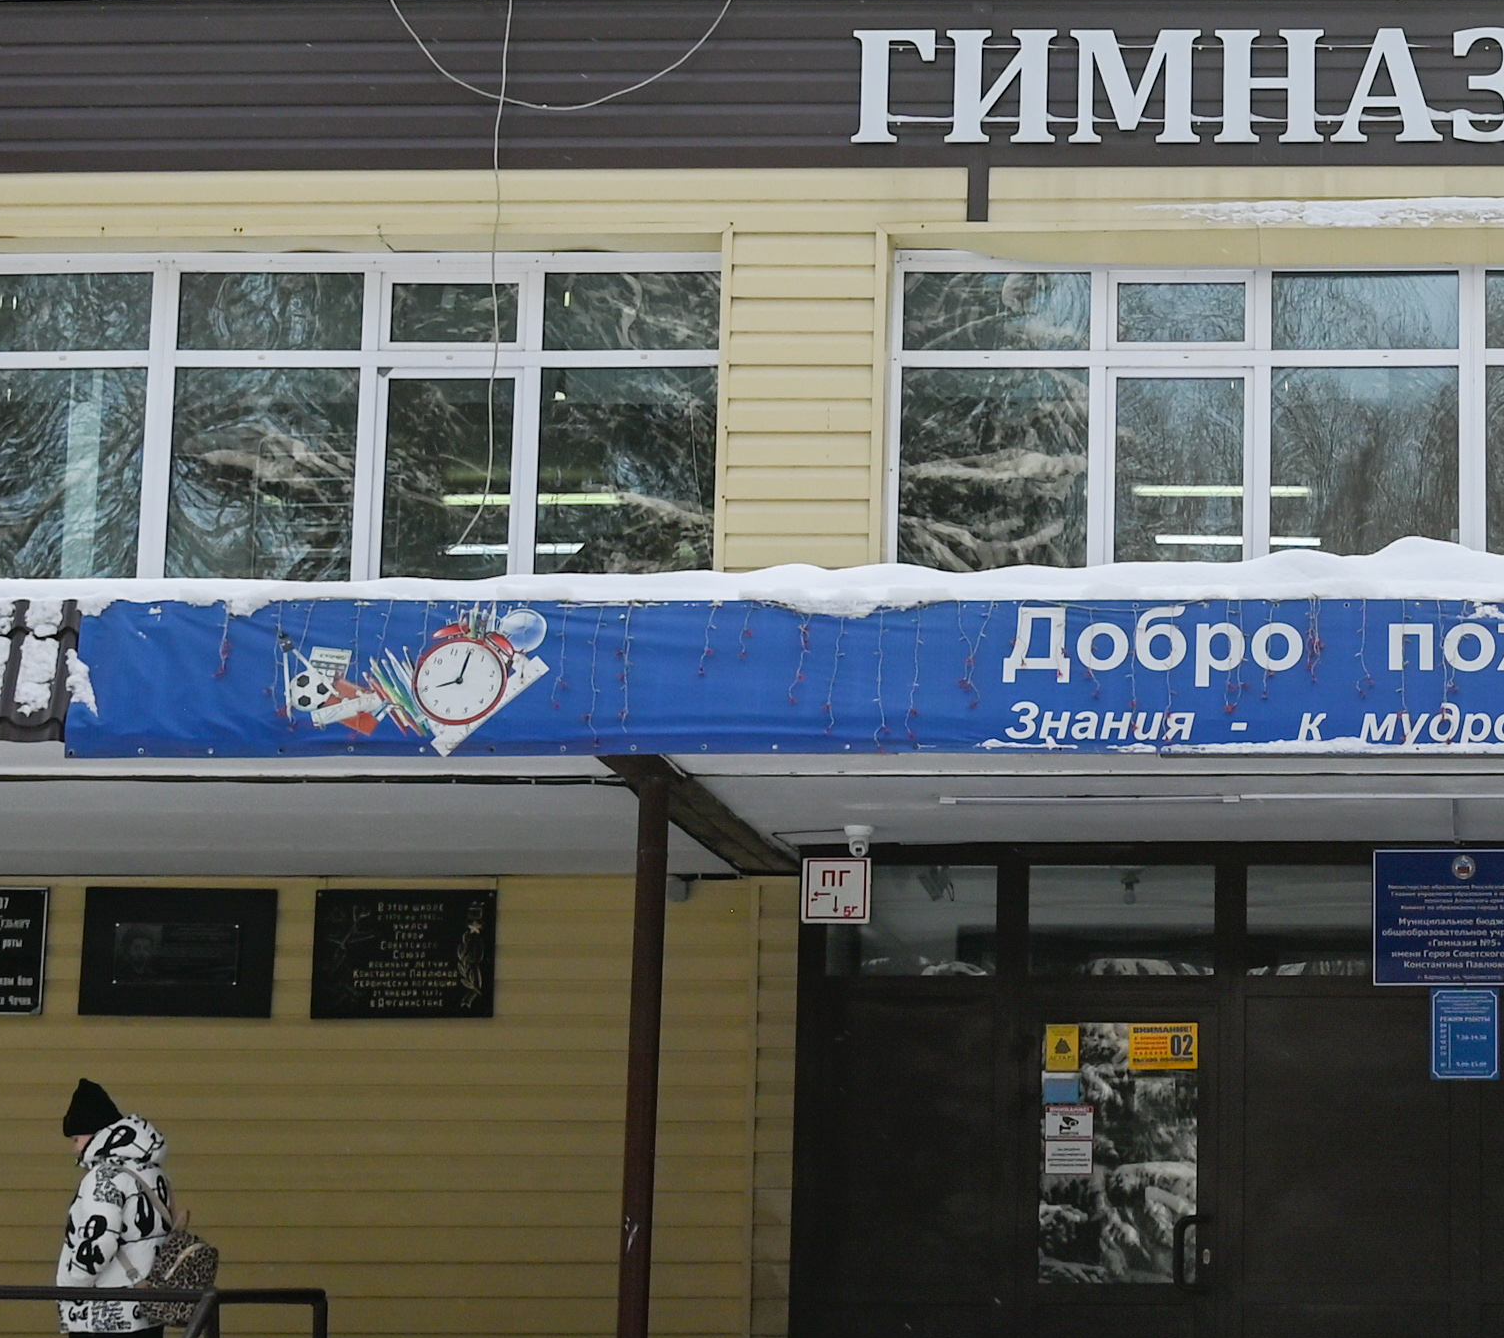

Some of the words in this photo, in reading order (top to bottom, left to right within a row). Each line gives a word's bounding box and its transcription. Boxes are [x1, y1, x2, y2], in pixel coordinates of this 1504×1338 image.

[1003, 605, 1303, 687] Добро
[1005, 701, 1195, 741] Знания
[1297, 712, 1327, 741] к
[822, 870, 851, 887] ПГ
[1398, 917, 1474, 927] Муниципальное
[1382, 928, 1487, 938] общеобразовательное
[2, 939, 22, 950] роты
[1423, 949, 1450, 959] Героя
[1403, 960, 1463, 969] Константина
[17, 975, 33, 987] бою
[1170, 1034, 1193, 1056] 02
